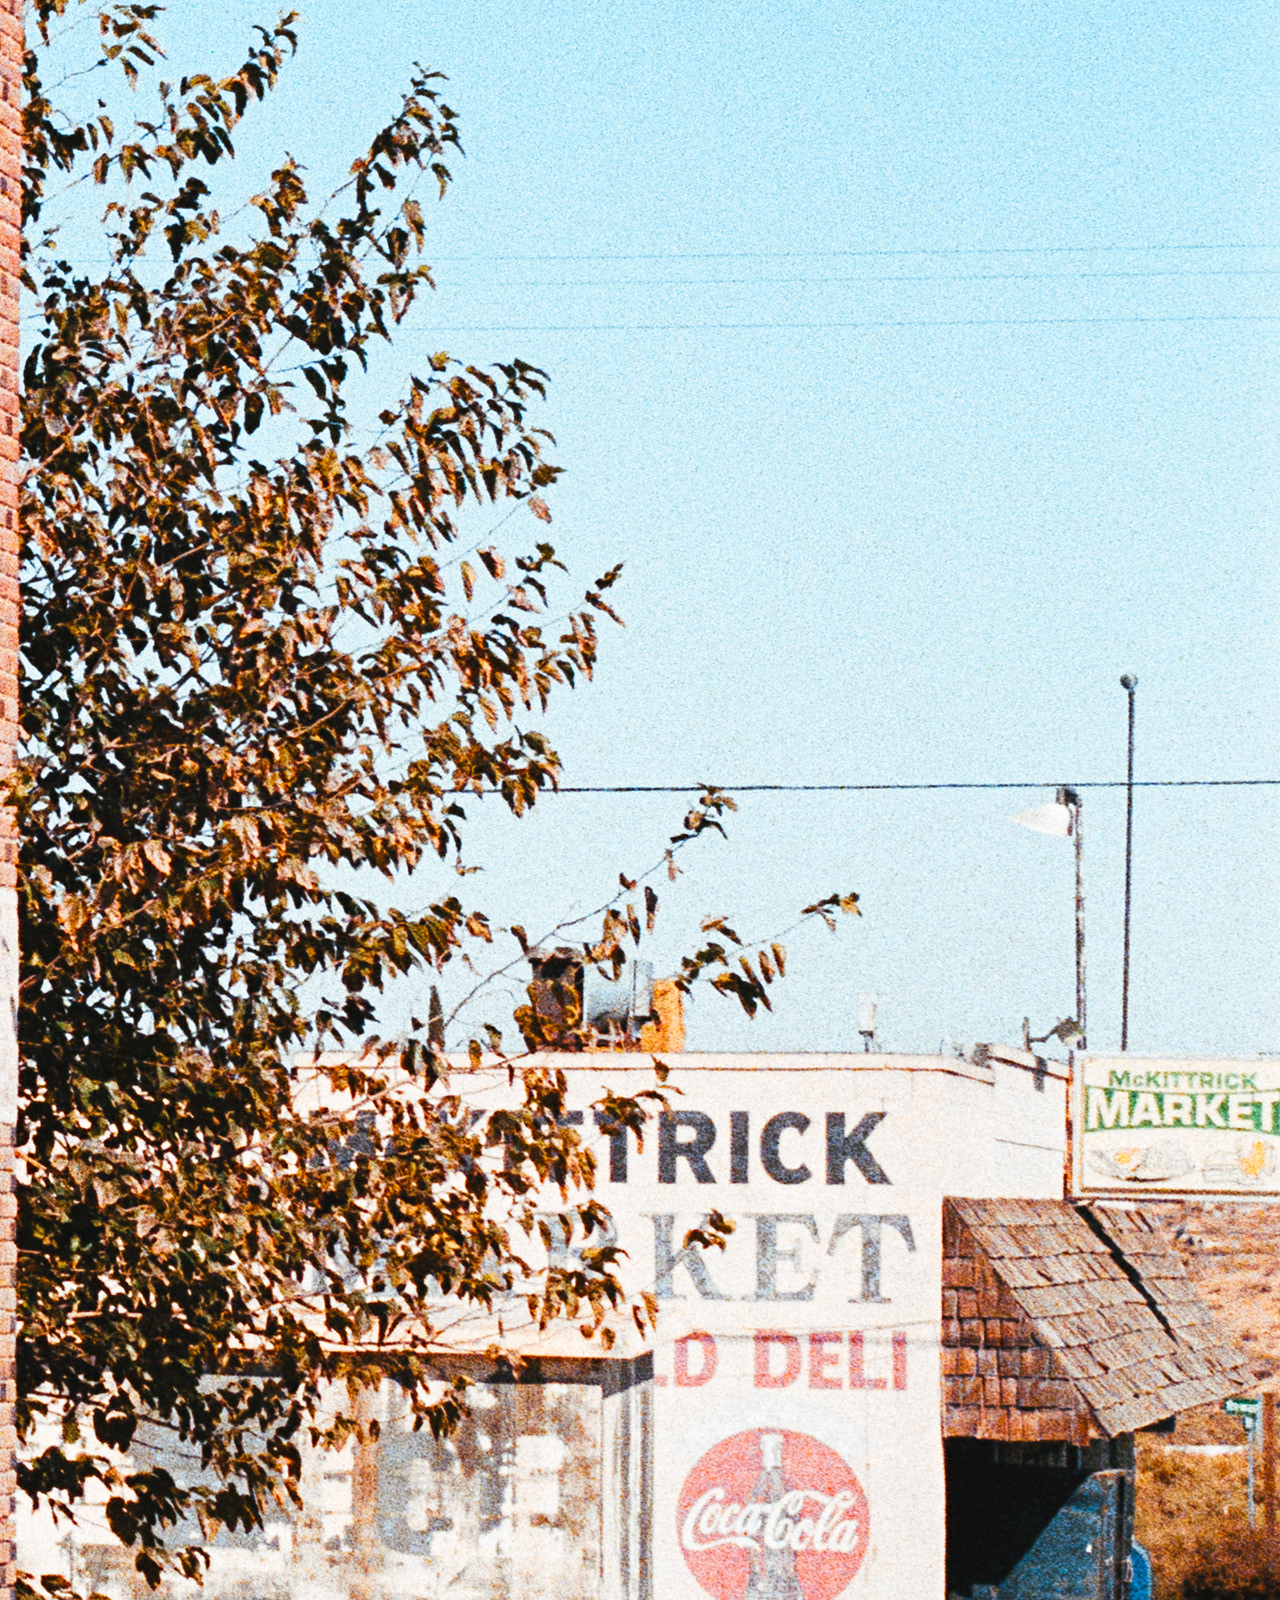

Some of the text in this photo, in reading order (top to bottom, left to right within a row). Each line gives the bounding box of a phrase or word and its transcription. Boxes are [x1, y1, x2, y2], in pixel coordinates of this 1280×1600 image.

[1108, 1069, 1258, 1090] McKITTRICK
[1087, 1087, 1280, 1133] MARKET
[753, 1328, 907, 1391] DELI
